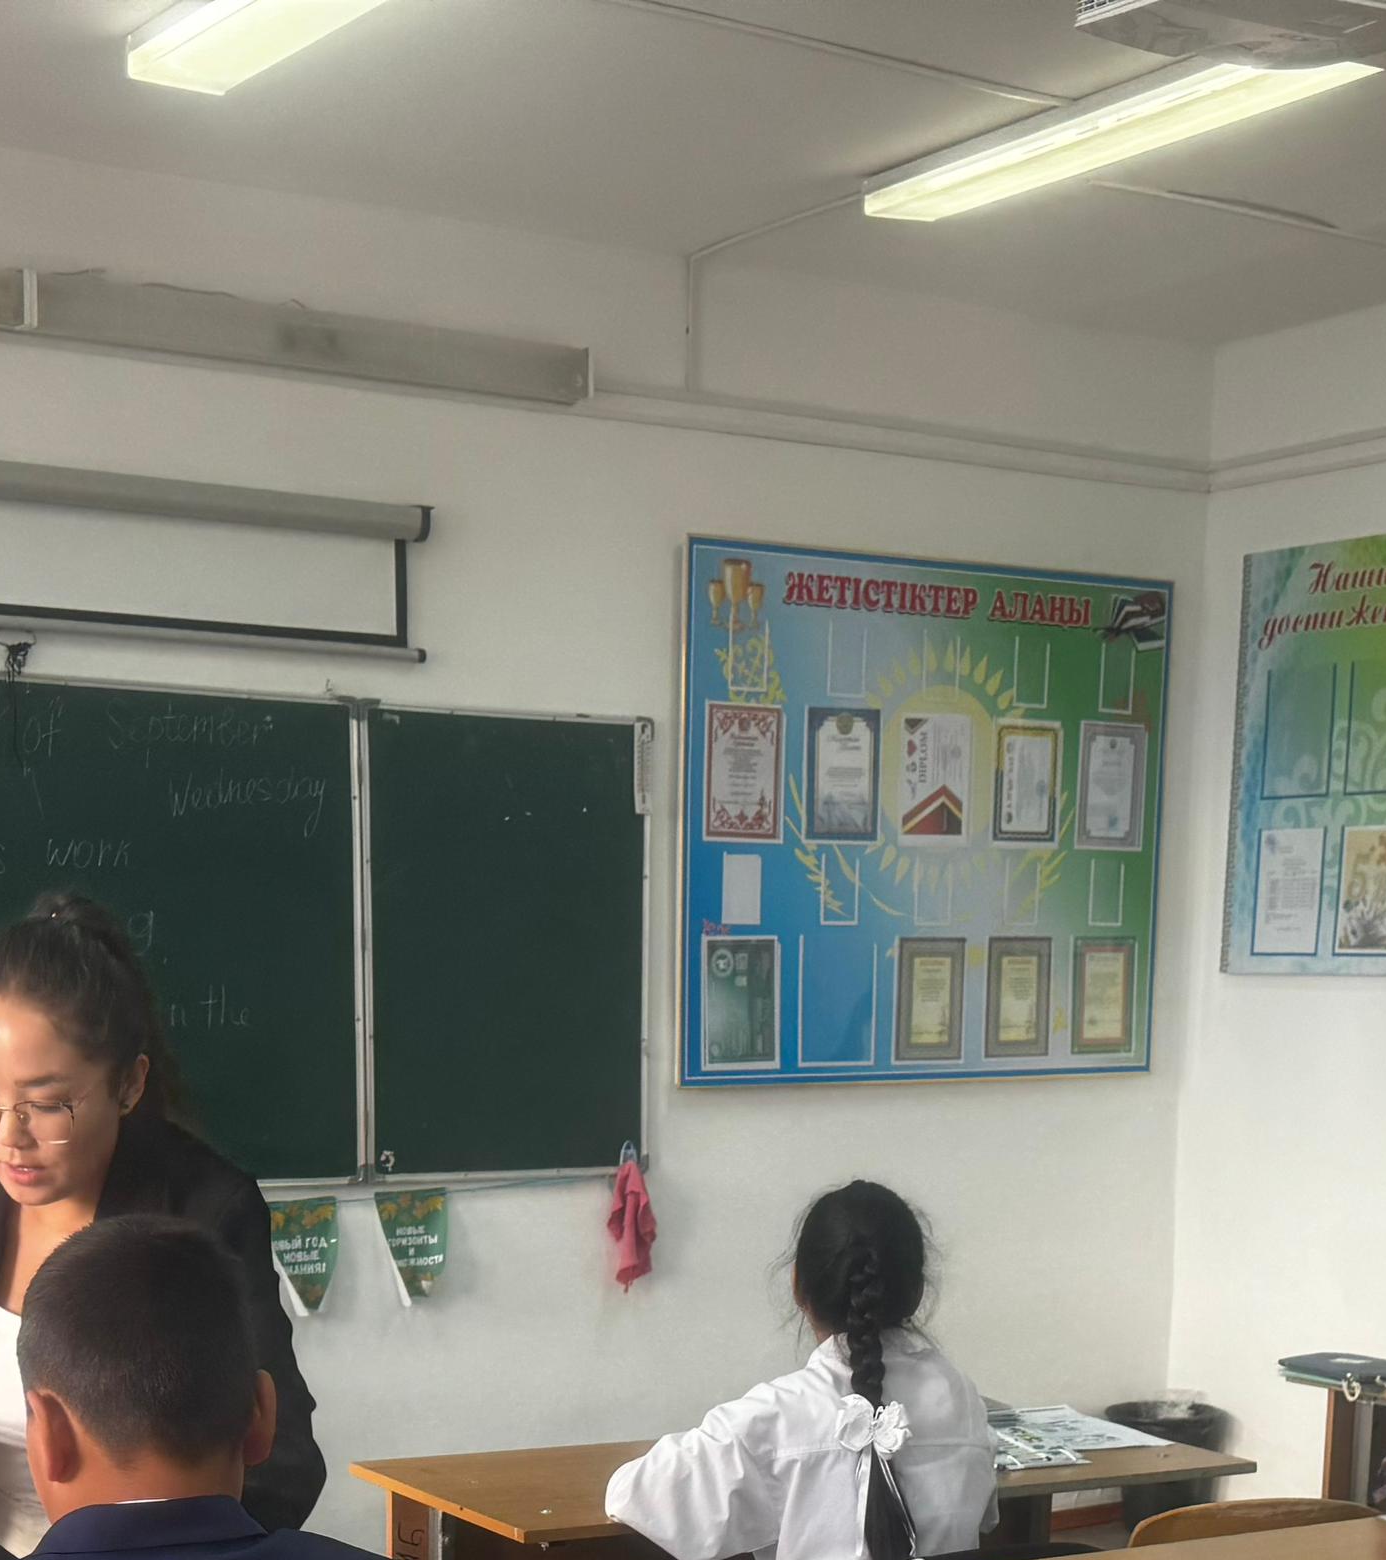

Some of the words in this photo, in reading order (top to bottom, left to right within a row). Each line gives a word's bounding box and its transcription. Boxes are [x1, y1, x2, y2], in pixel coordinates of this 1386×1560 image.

[783, 570, 979, 619] ЖЕТІСТІКТЕР
[988, 588, 1093, 628] АЛАҢЫ
[108, 697, 273, 769] September
[169, 767, 326, 838] Wednesday
[46, 838, 134, 868] work
[305, 1236, 328, 1248] ГОД
